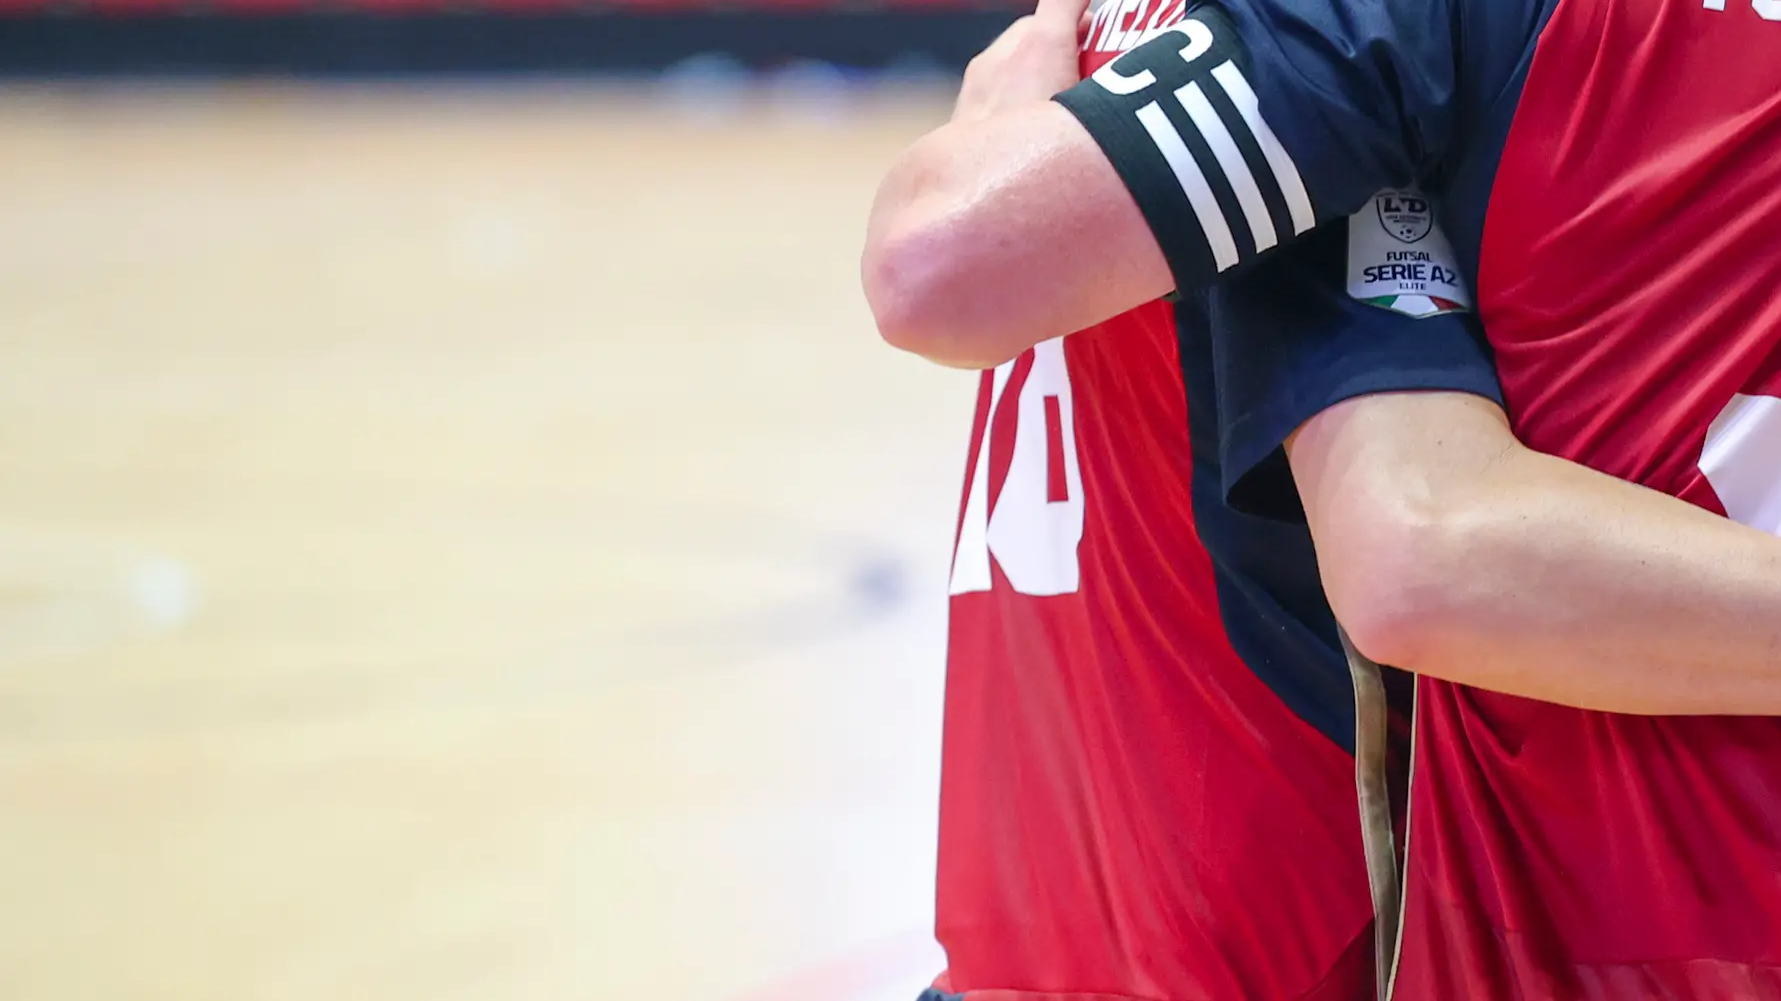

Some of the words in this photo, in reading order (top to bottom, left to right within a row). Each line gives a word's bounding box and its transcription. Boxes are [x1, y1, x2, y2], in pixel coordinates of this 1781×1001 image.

[1092, 18, 1214, 95] C
[1386, 250, 1433, 262] FUTSAL
[1363, 263, 1427, 284] SERIE
[1430, 265, 1459, 288] A2
